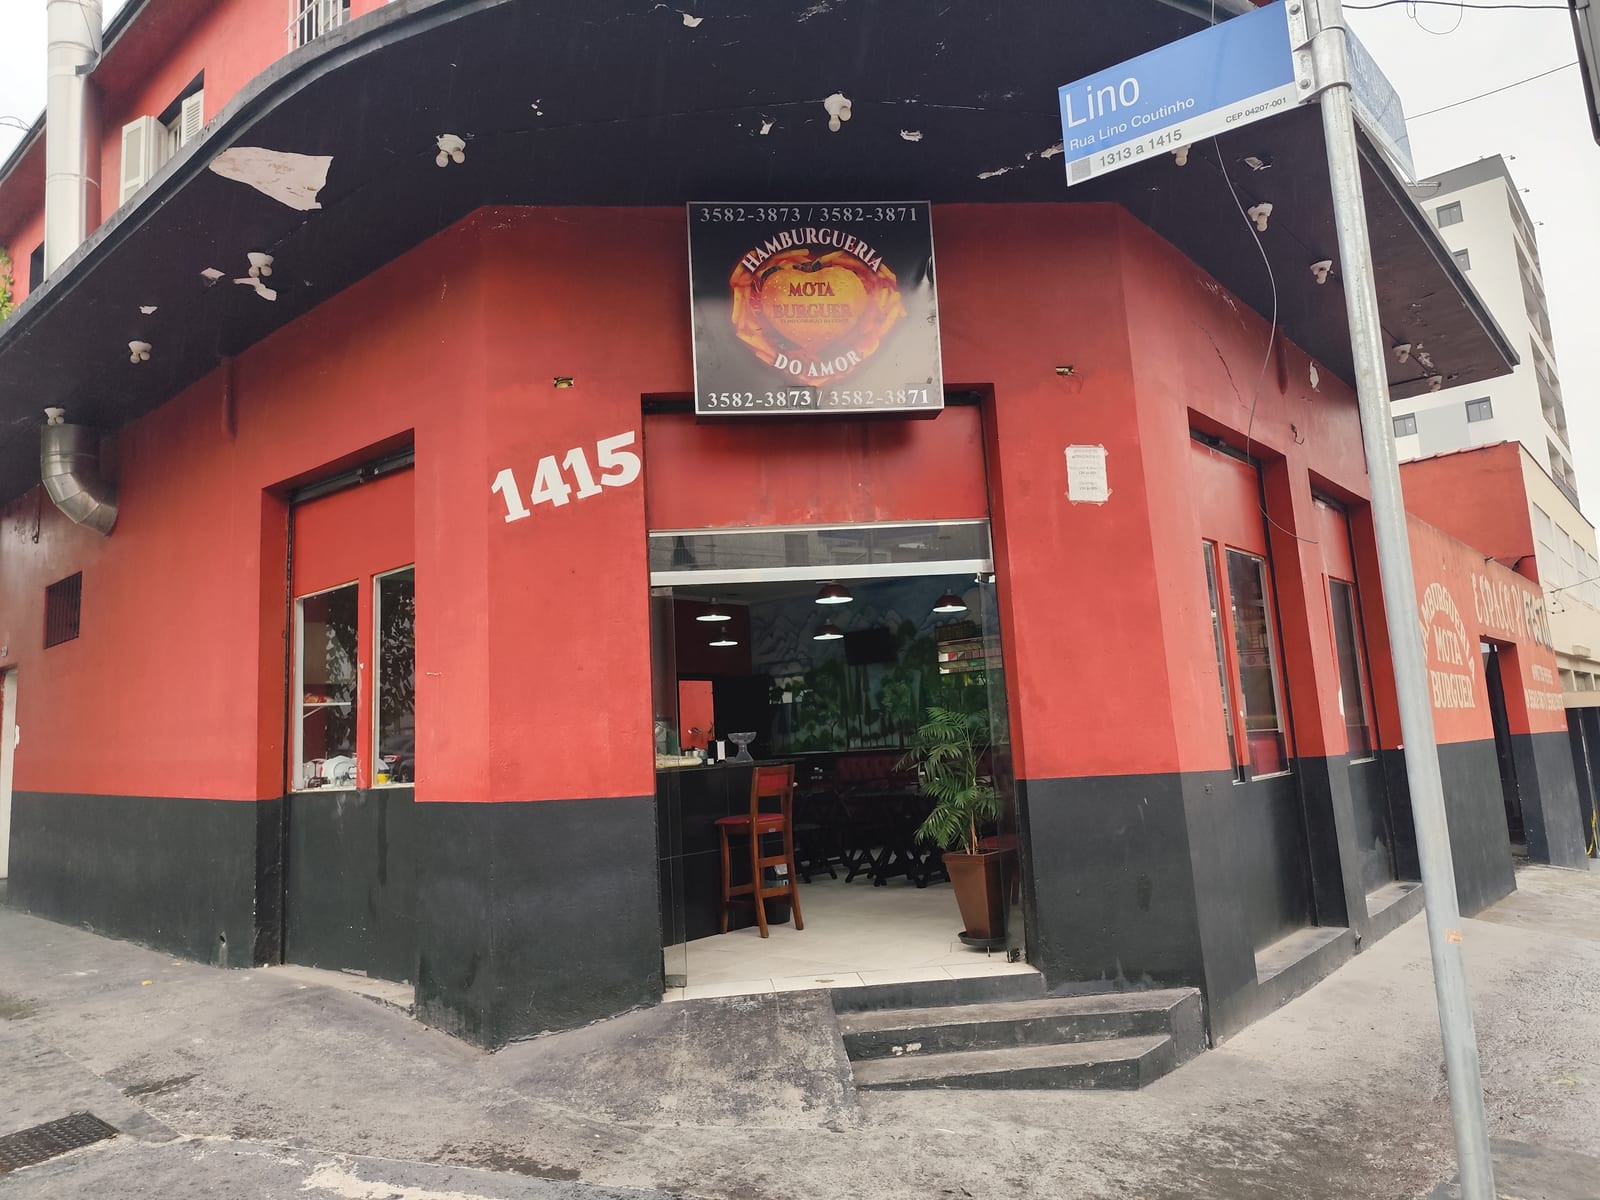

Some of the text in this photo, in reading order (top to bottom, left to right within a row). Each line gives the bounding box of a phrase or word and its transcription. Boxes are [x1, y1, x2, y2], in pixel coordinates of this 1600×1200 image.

[1064, 76, 1140, 129] Lino
[1225, 96, 1288, 123] CEP 04207-001
[1069, 95, 1196, 151] Rua Lino Coutinho
[1098, 128, 1183, 168] 1313 a 1415
[700, 206, 918, 222] 3582-3873 / 3582-3871
[741, 226, 884, 274] HAMBURGUERIA
[788, 281, 836, 297] MOTA
[772, 302, 853, 319] BURGUER
[773, 350, 863, 378] DO AMOR
[707, 390, 811, 408] 3582-3873
[830, 389, 930, 406] 3582-3871
[491, 430, 641, 523] 1415
[1419, 582, 1475, 683] AMBURGUERIA
[1433, 624, 1464, 666] MOTA
[1430, 670, 1476, 709] BURGUER
